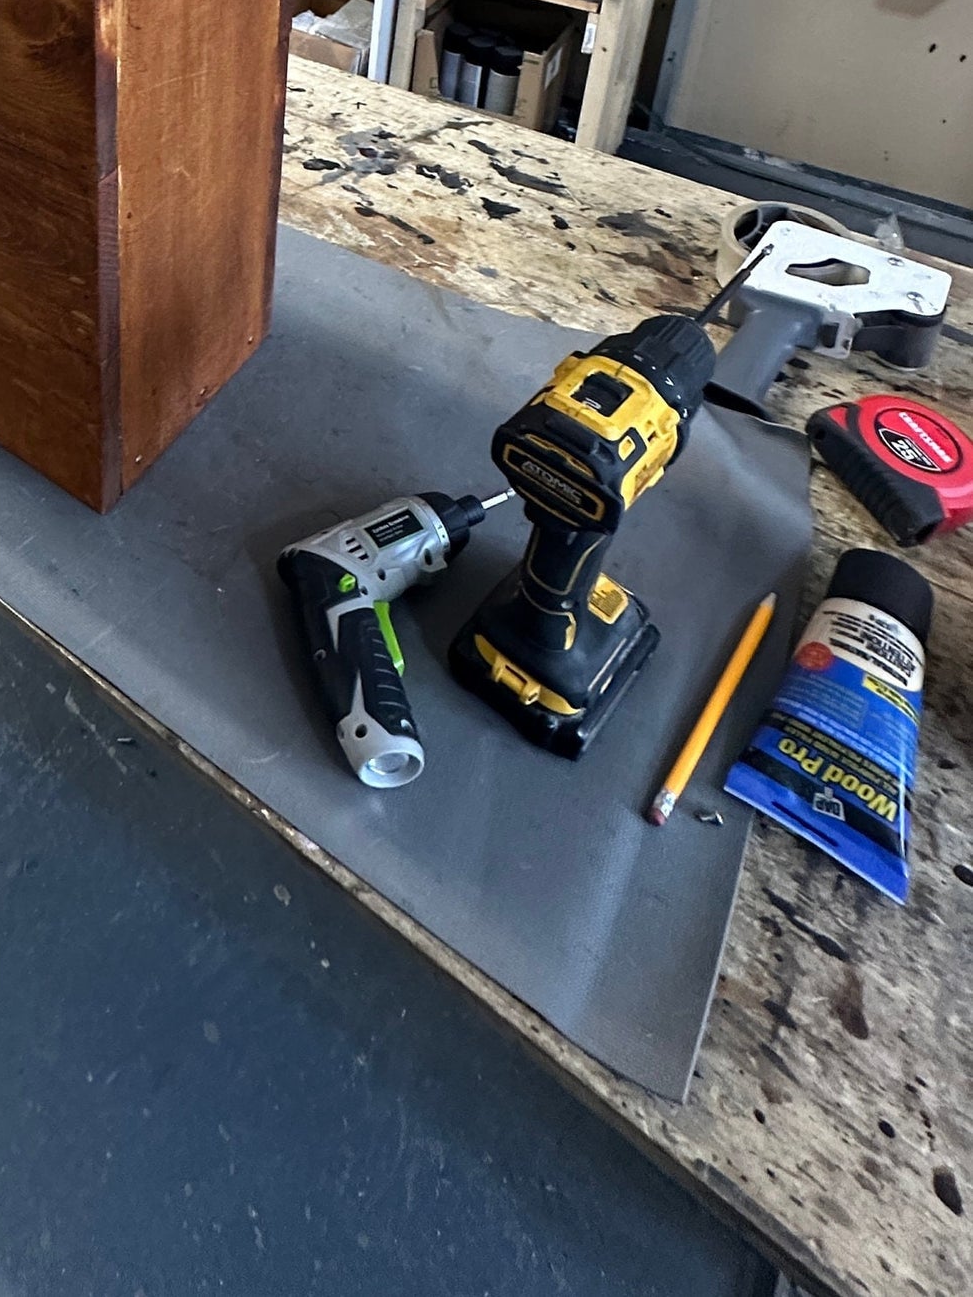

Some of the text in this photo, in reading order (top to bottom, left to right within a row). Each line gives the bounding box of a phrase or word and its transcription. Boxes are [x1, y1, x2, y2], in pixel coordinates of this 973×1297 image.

[890, 439, 916, 461] 25
[521, 461, 583, 503] ATOMIC
[777, 737, 825, 776] Pro
[821, 764, 898, 822] Wood
